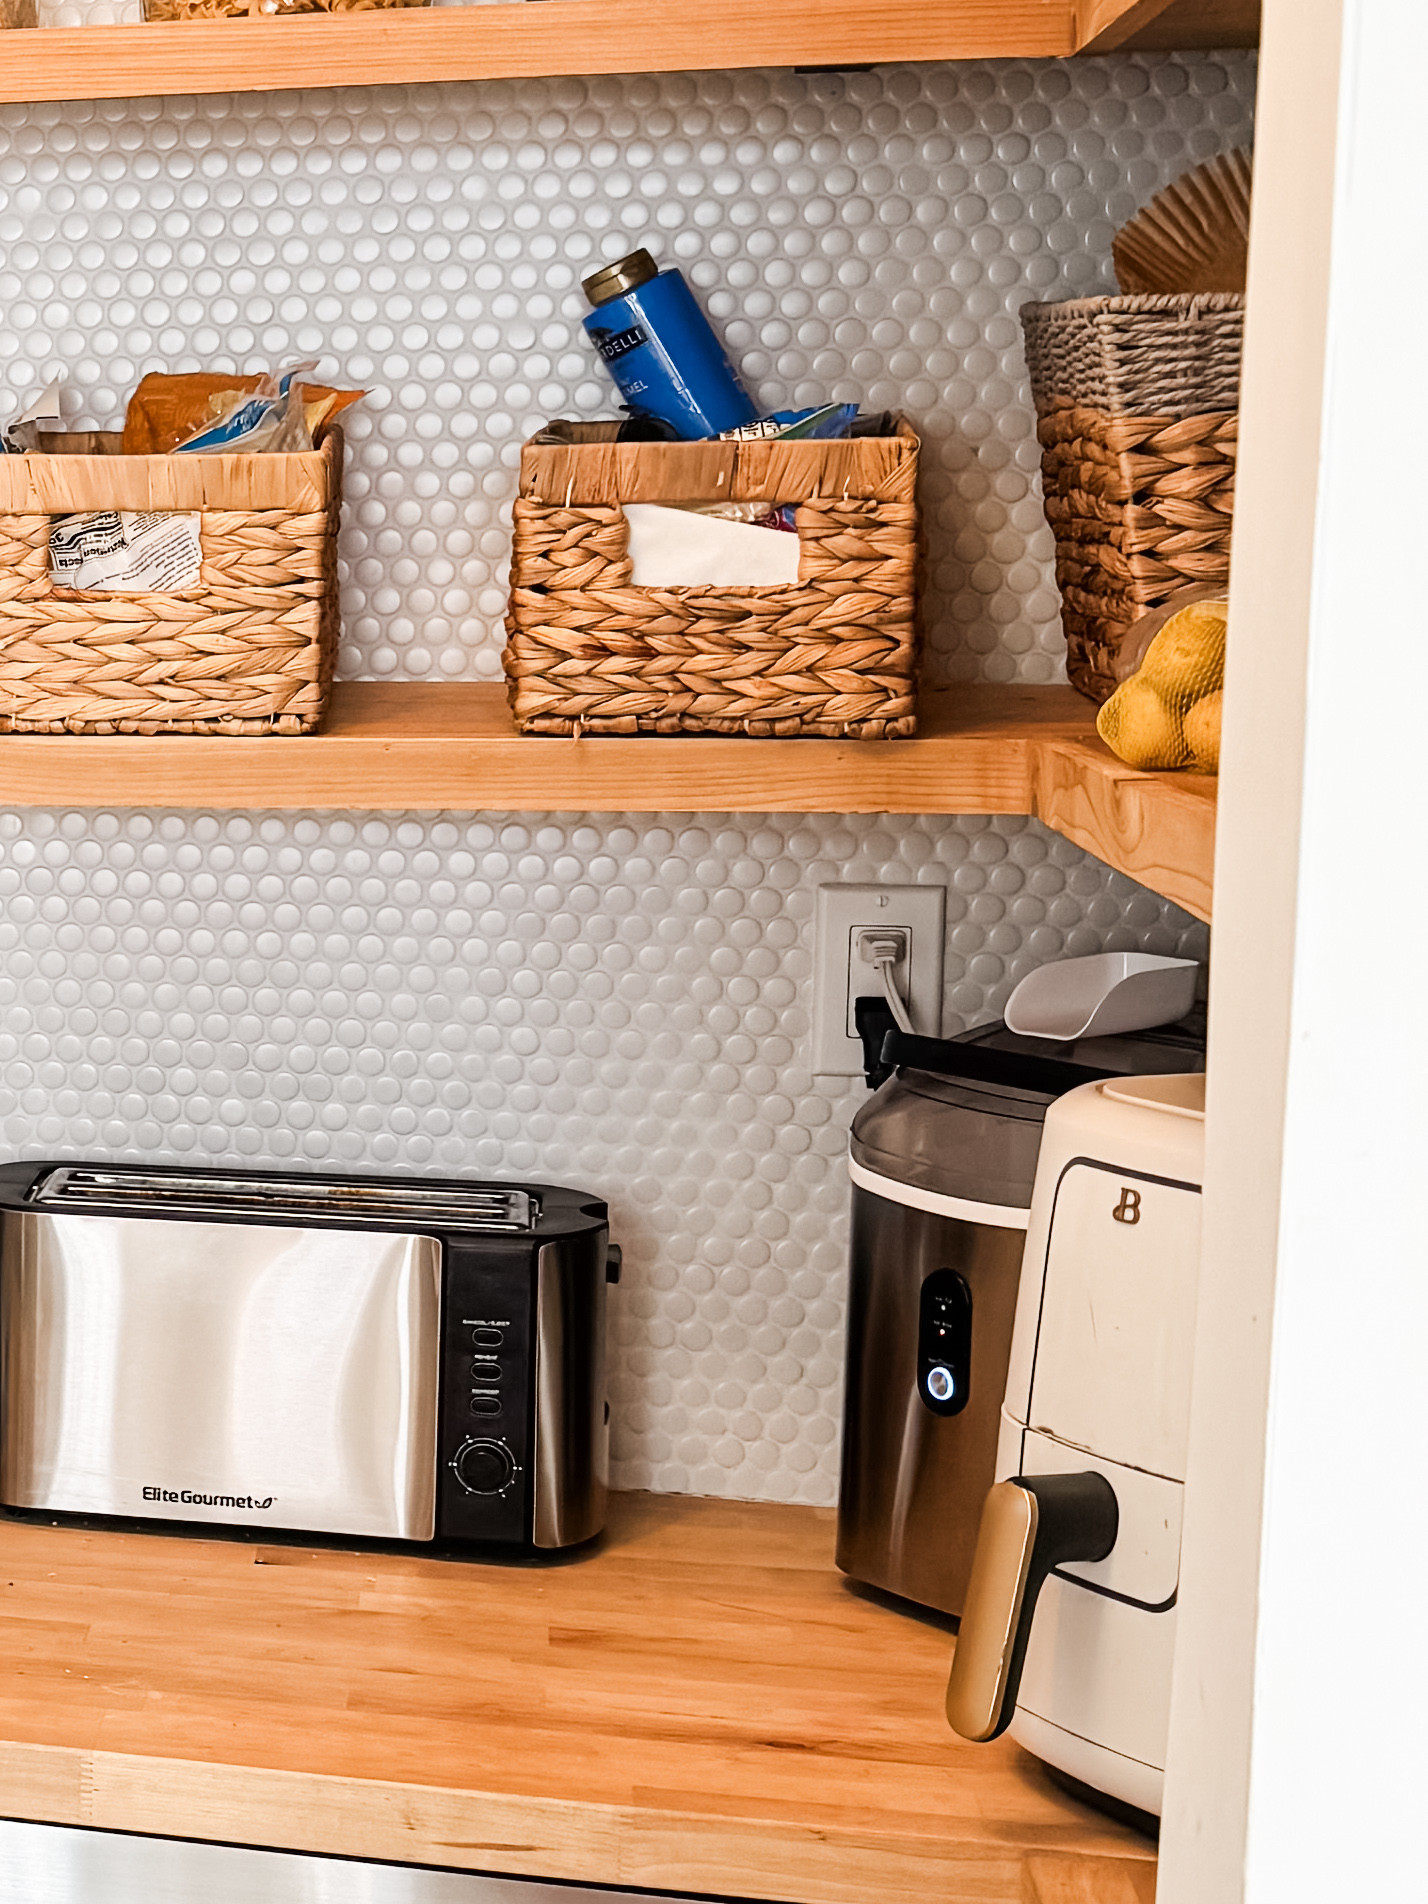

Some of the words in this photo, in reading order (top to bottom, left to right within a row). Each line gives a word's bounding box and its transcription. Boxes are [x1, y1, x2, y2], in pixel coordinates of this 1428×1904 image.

[1112, 1187, 1142, 1226] B
[142, 1486, 179, 1503] Elite
[180, 1490, 254, 1509] Gourmet
